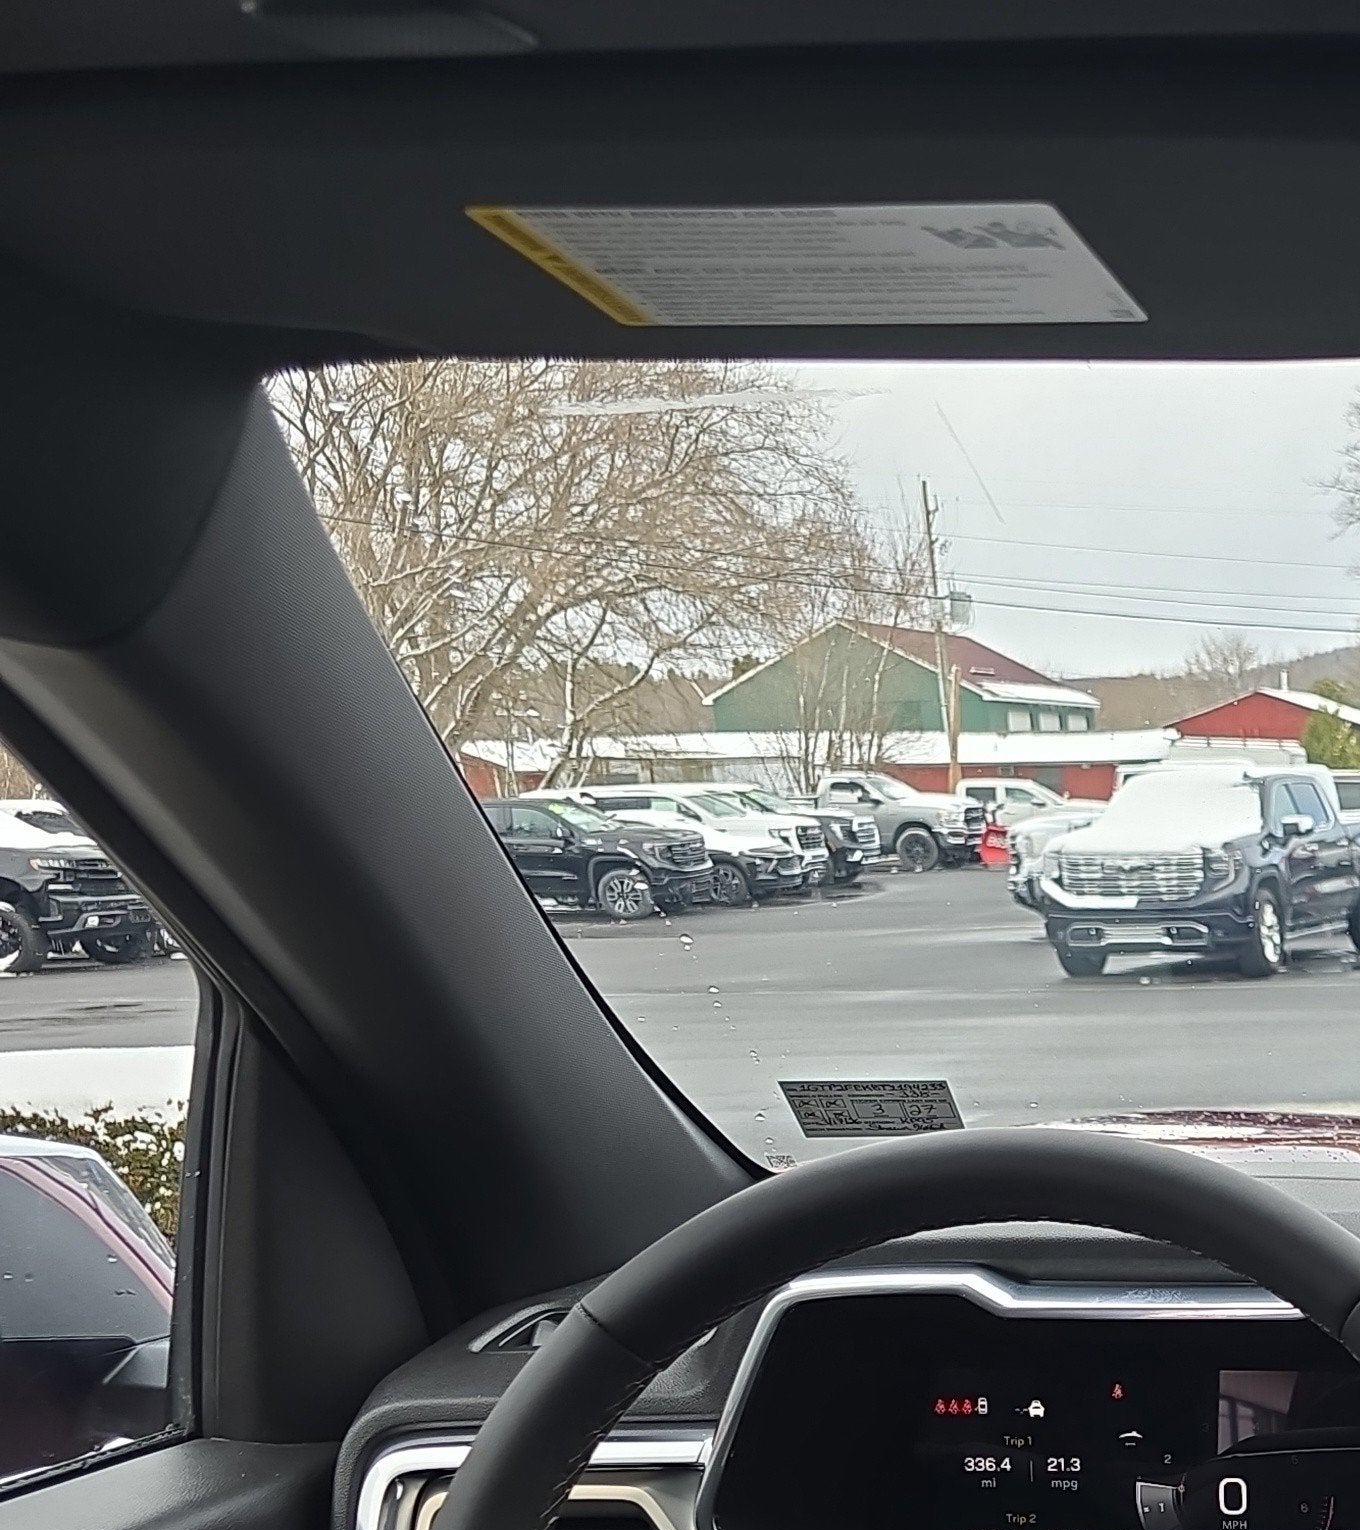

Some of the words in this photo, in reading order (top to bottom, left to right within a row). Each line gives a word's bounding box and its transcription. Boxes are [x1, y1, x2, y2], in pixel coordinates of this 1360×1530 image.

[1004, 1436, 1025, 1448] Trip
[1027, 1436, 1032, 1446] 1
[963, 1457, 1012, 1472] 336.4
[1047, 1457, 1081, 1472] 21.3
[1164, 1454, 1172, 1464] 2
[981, 1478, 997, 1488] mi
[1051, 1478, 1079, 1490] mpg
[1218, 1477, 1248, 1516] 0
[1006, 1514, 1027, 1525] Trip
[1029, 1514, 1037, 1524] 2
[1222, 1520, 1248, 1530] MPH
